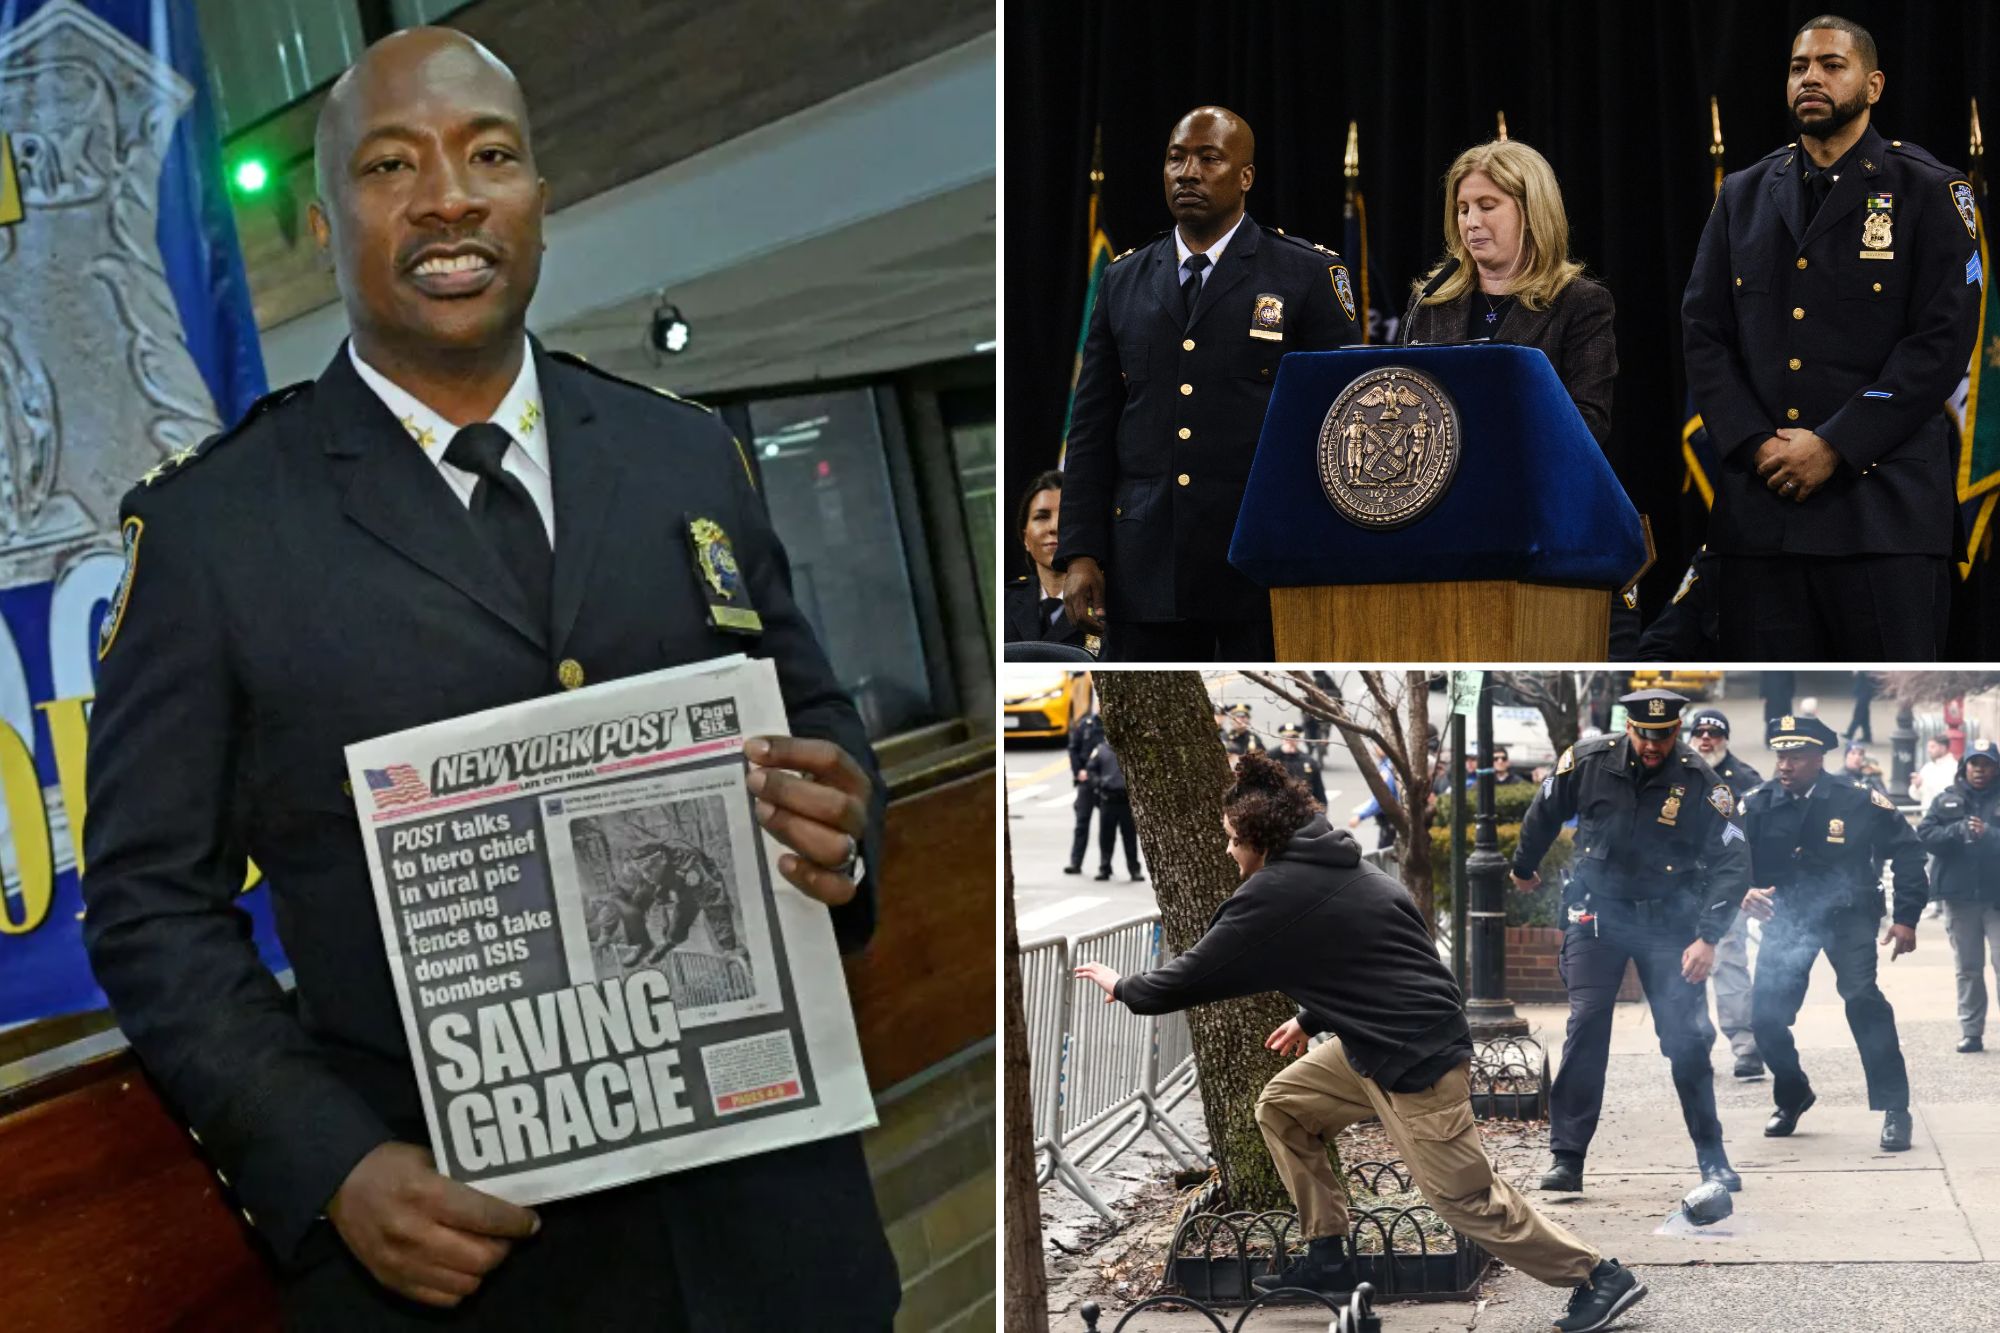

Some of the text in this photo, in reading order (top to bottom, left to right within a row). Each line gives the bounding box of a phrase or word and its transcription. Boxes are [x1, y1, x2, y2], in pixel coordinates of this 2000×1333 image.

[1369, 487, 1396, 498] 1625
[691, 703, 735, 722] Page
[700, 718, 728, 734] Six
[431, 744, 507, 797] NEW
[508, 727, 596, 780] YORK
[594, 707, 678, 763] POST
[392, 829, 536, 880] to hero chief
[393, 813, 511, 853] POST talks
[398, 863, 522, 906] in viral pic
[402, 895, 500, 937] jumping
[408, 910, 553, 957] fence to take
[415, 938, 531, 982] down ISIS
[418, 970, 524, 1009] bombers
[427, 968, 682, 1093] SAVING
[446, 1048, 696, 1173] GRACIE
